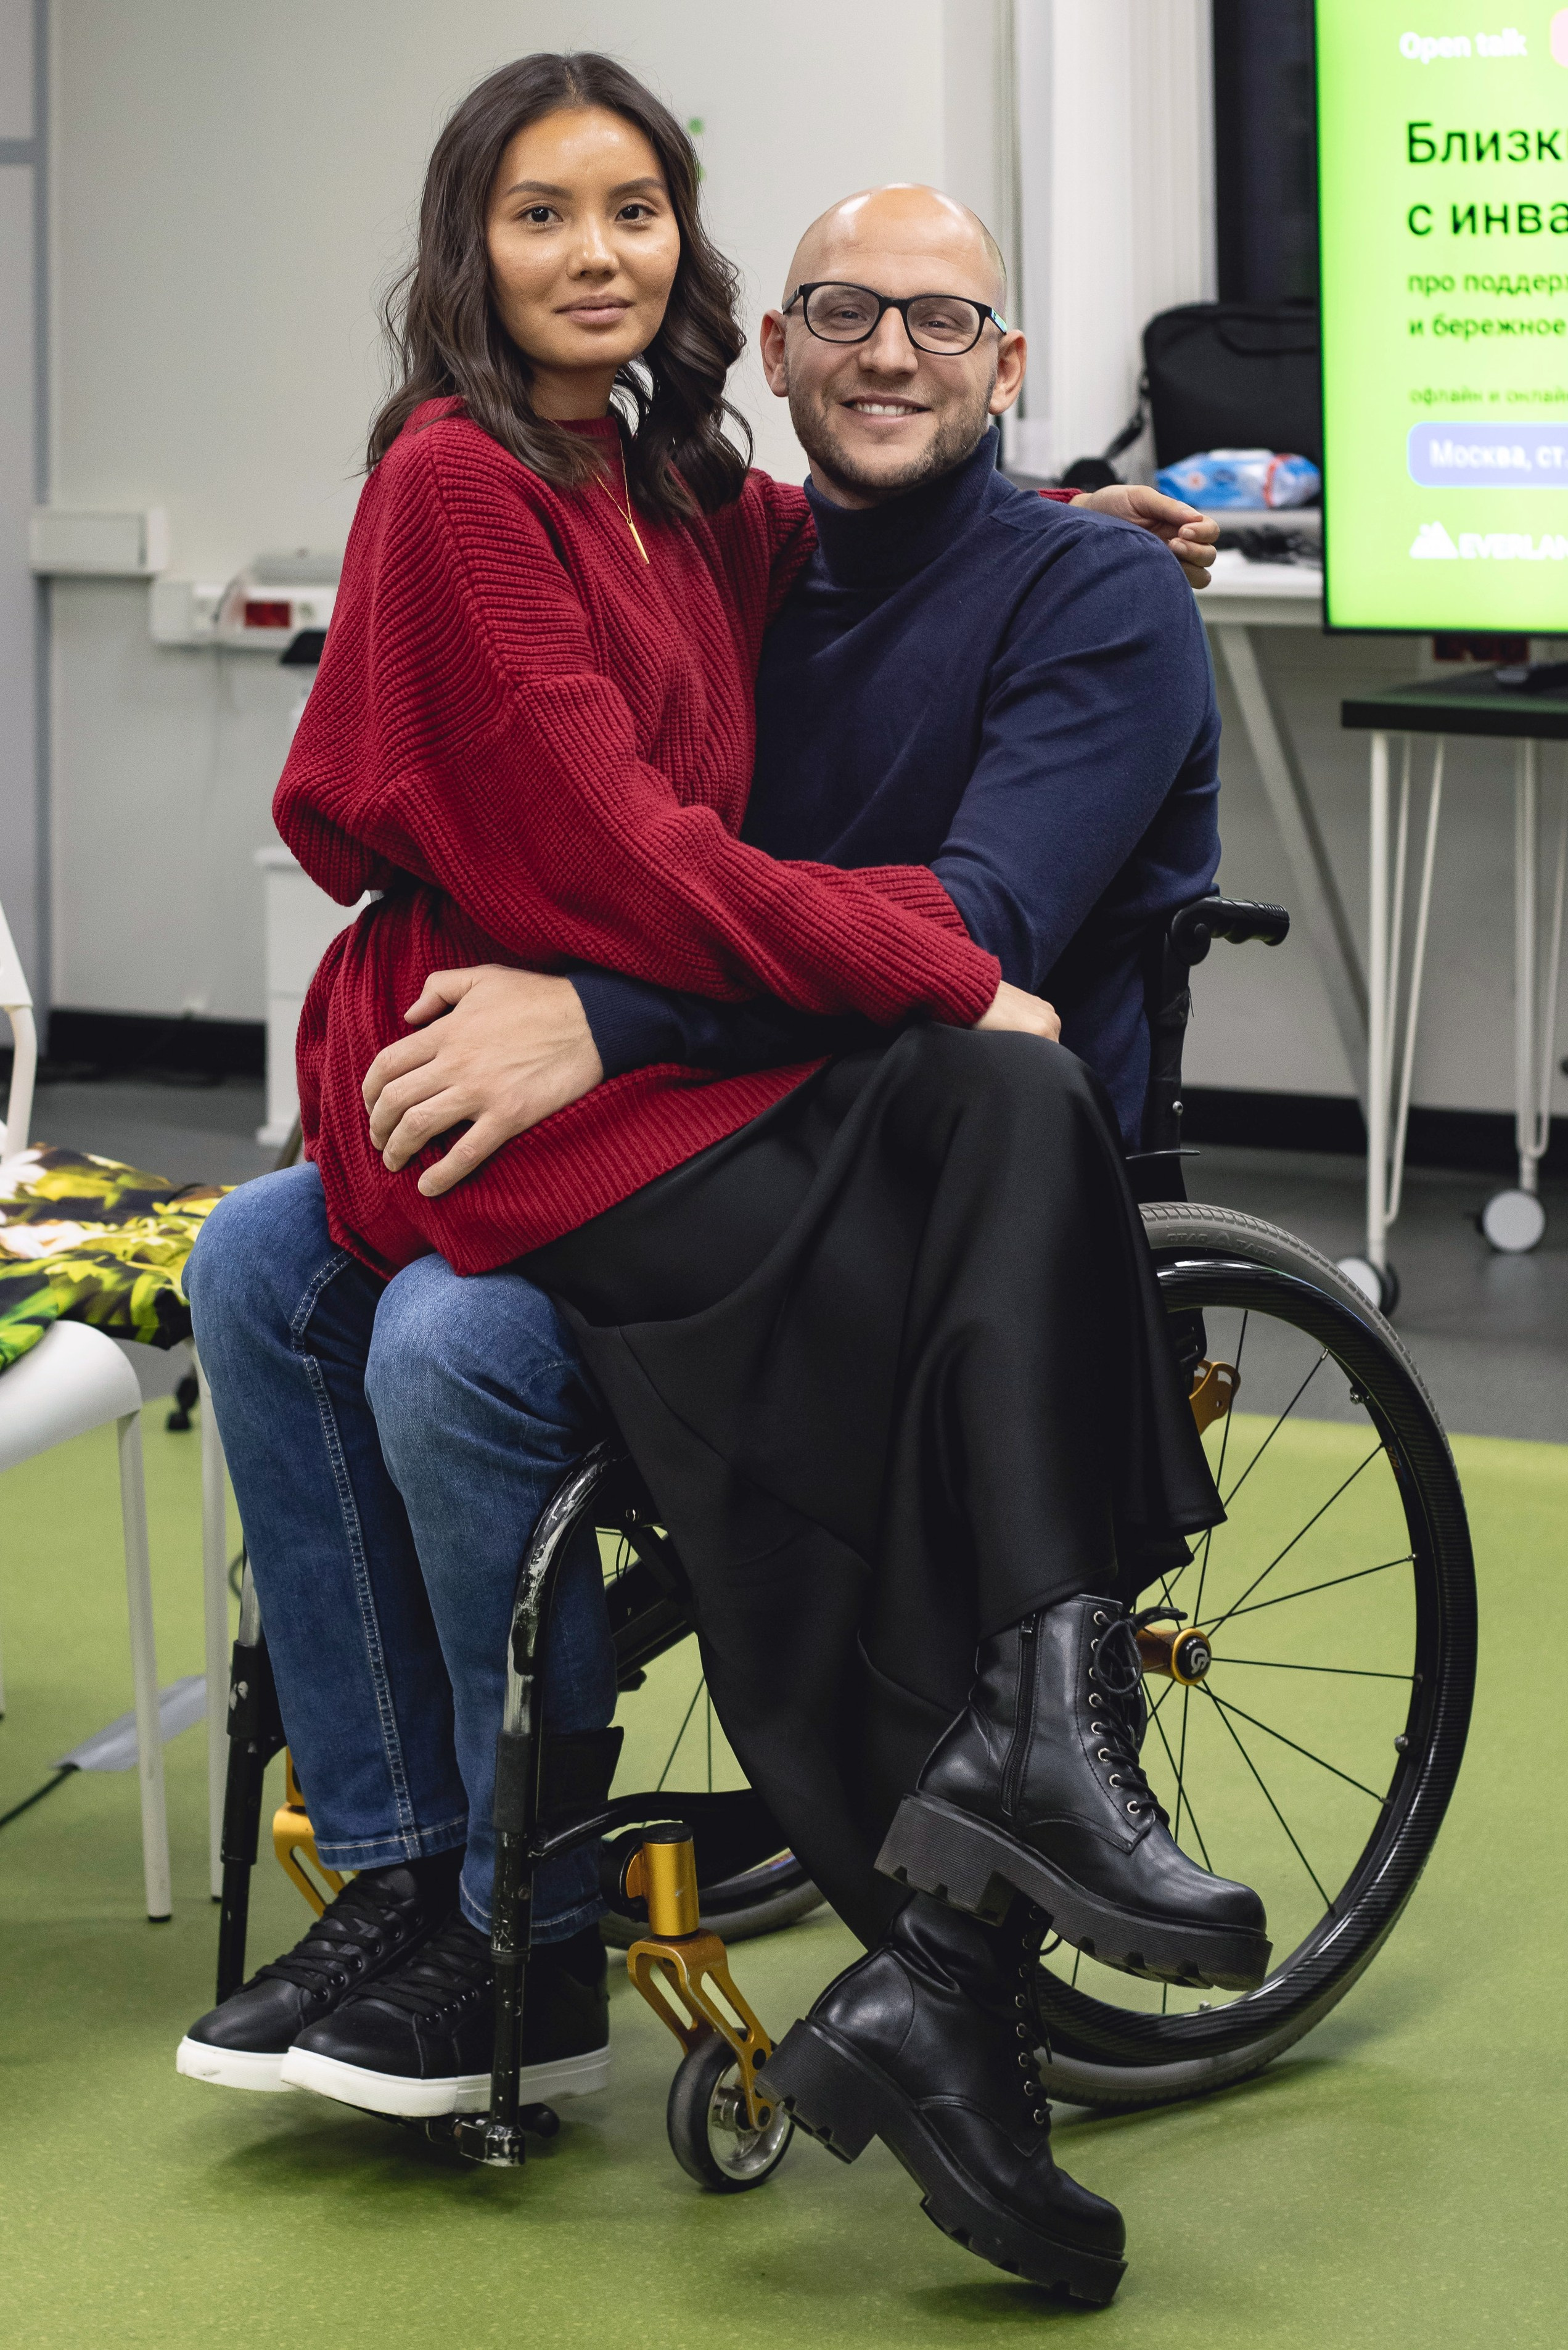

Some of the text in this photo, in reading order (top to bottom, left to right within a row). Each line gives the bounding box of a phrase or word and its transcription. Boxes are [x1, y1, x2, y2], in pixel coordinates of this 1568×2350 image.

[1399, 27, 1527, 65] Open talk
[1408, 121, 1568, 164] Близк
[1408, 203, 1568, 236] с инва
[1408, 273, 1568, 297] про поддер
[1409, 313, 1566, 342] и бережное
[1487, 391, 1500, 403] и
[1429, 439, 1533, 472] Москва,
